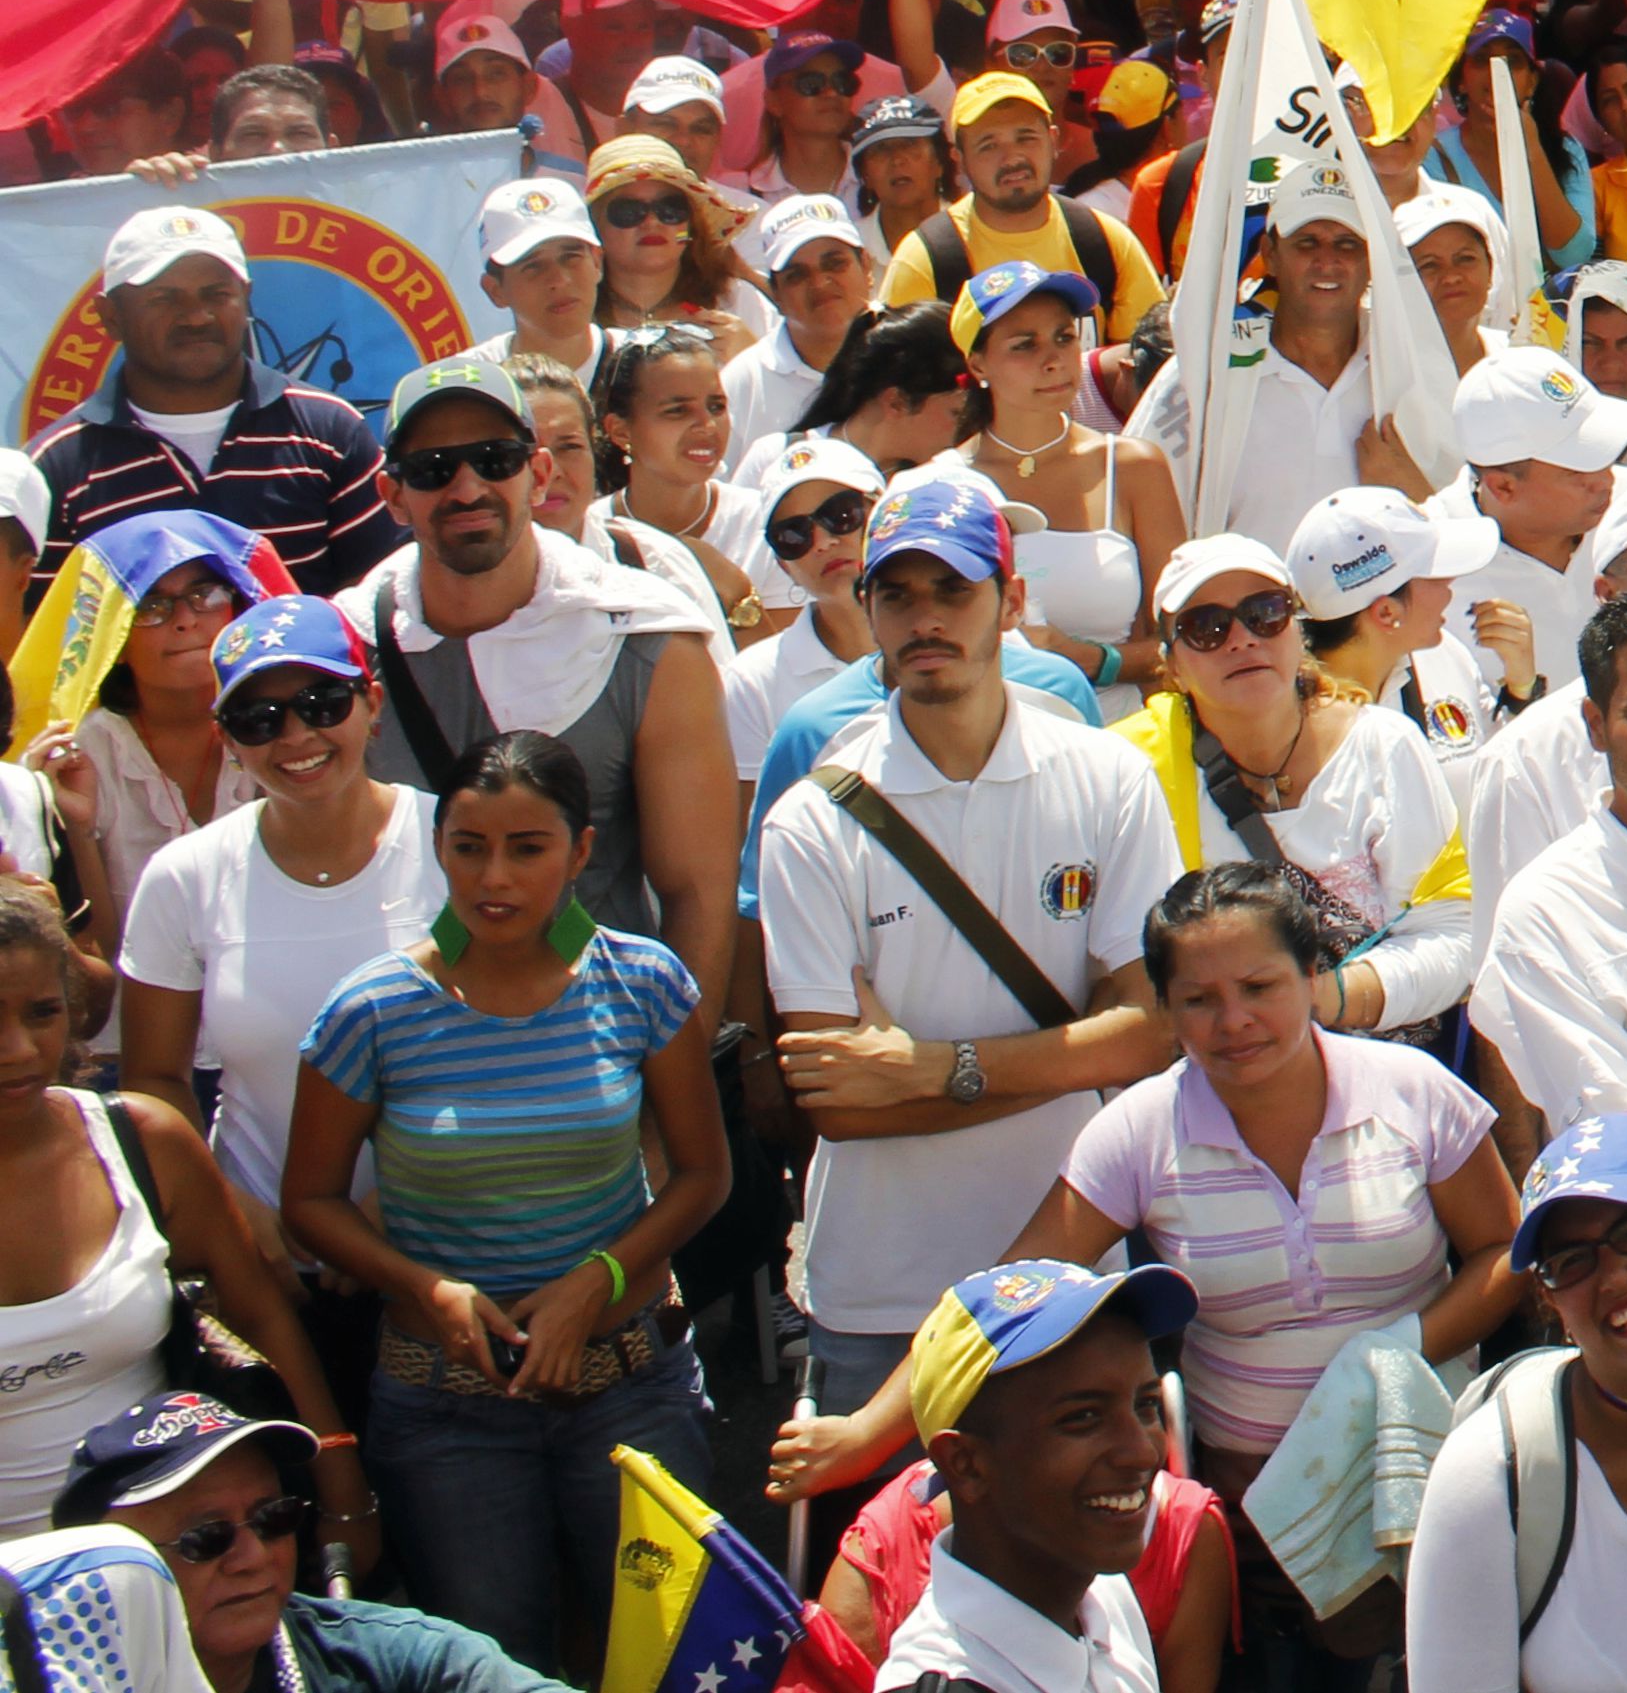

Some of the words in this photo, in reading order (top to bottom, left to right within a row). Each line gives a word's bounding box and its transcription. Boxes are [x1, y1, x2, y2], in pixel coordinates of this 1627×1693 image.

[275, 209, 348, 254] DE
[366, 244, 462, 359] ORIE
[1332, 544, 1387, 575] Oswaldo
[867, 911, 897, 927] uan
[897, 905, 914, 920] F.
